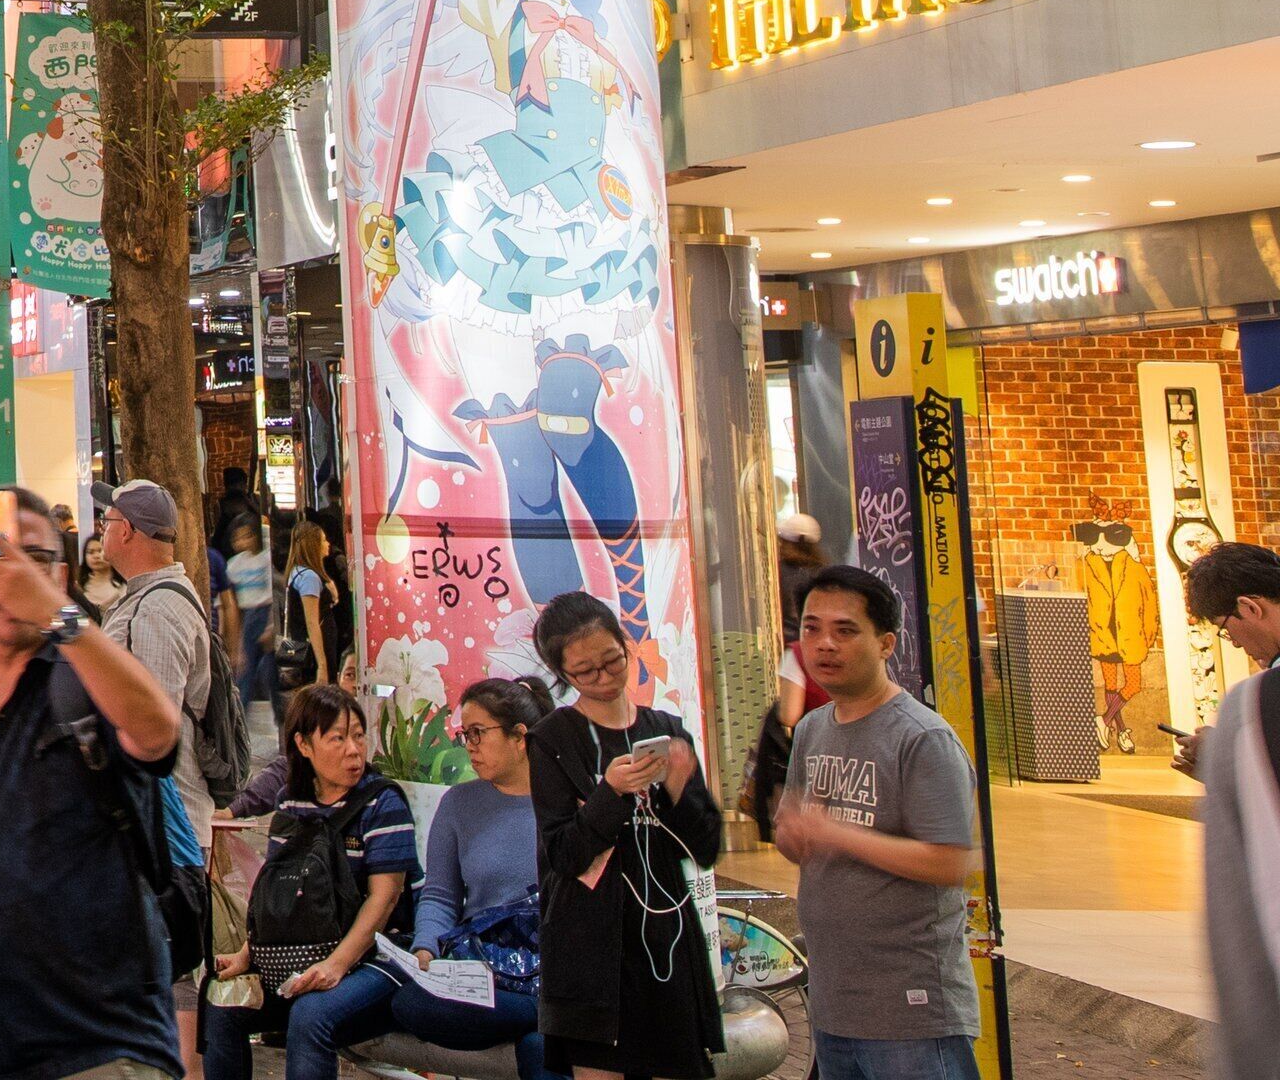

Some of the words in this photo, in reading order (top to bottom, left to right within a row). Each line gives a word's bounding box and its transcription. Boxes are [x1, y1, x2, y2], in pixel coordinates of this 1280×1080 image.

[244, 10, 259, 22] 2F
[41, 255, 65, 267] Happy
[68, 260, 93, 271] Happy
[95, 263, 112, 271] Hab
[995, 251, 1098, 307] swatch
[806, 754, 878, 807] PUMA
[842, 807, 876, 828] FIELD
